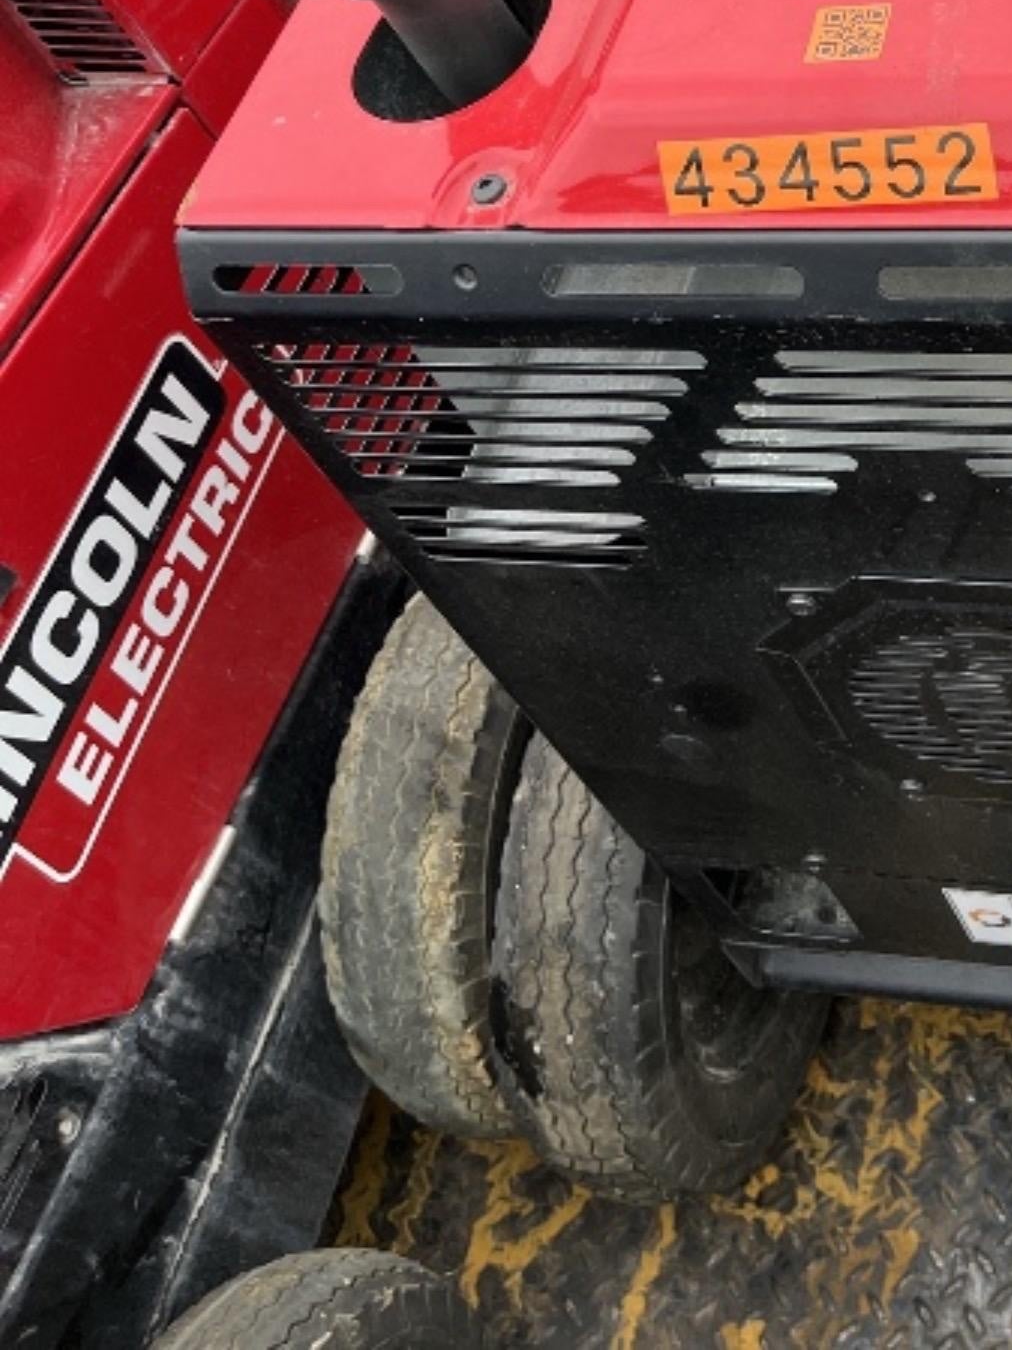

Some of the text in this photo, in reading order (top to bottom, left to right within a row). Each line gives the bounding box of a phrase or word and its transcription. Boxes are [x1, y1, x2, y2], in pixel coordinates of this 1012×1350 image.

[674, 131, 982, 208] 434552
[0, 372, 211, 830] NCOLN
[56, 388, 273, 806] ELECTRIC
